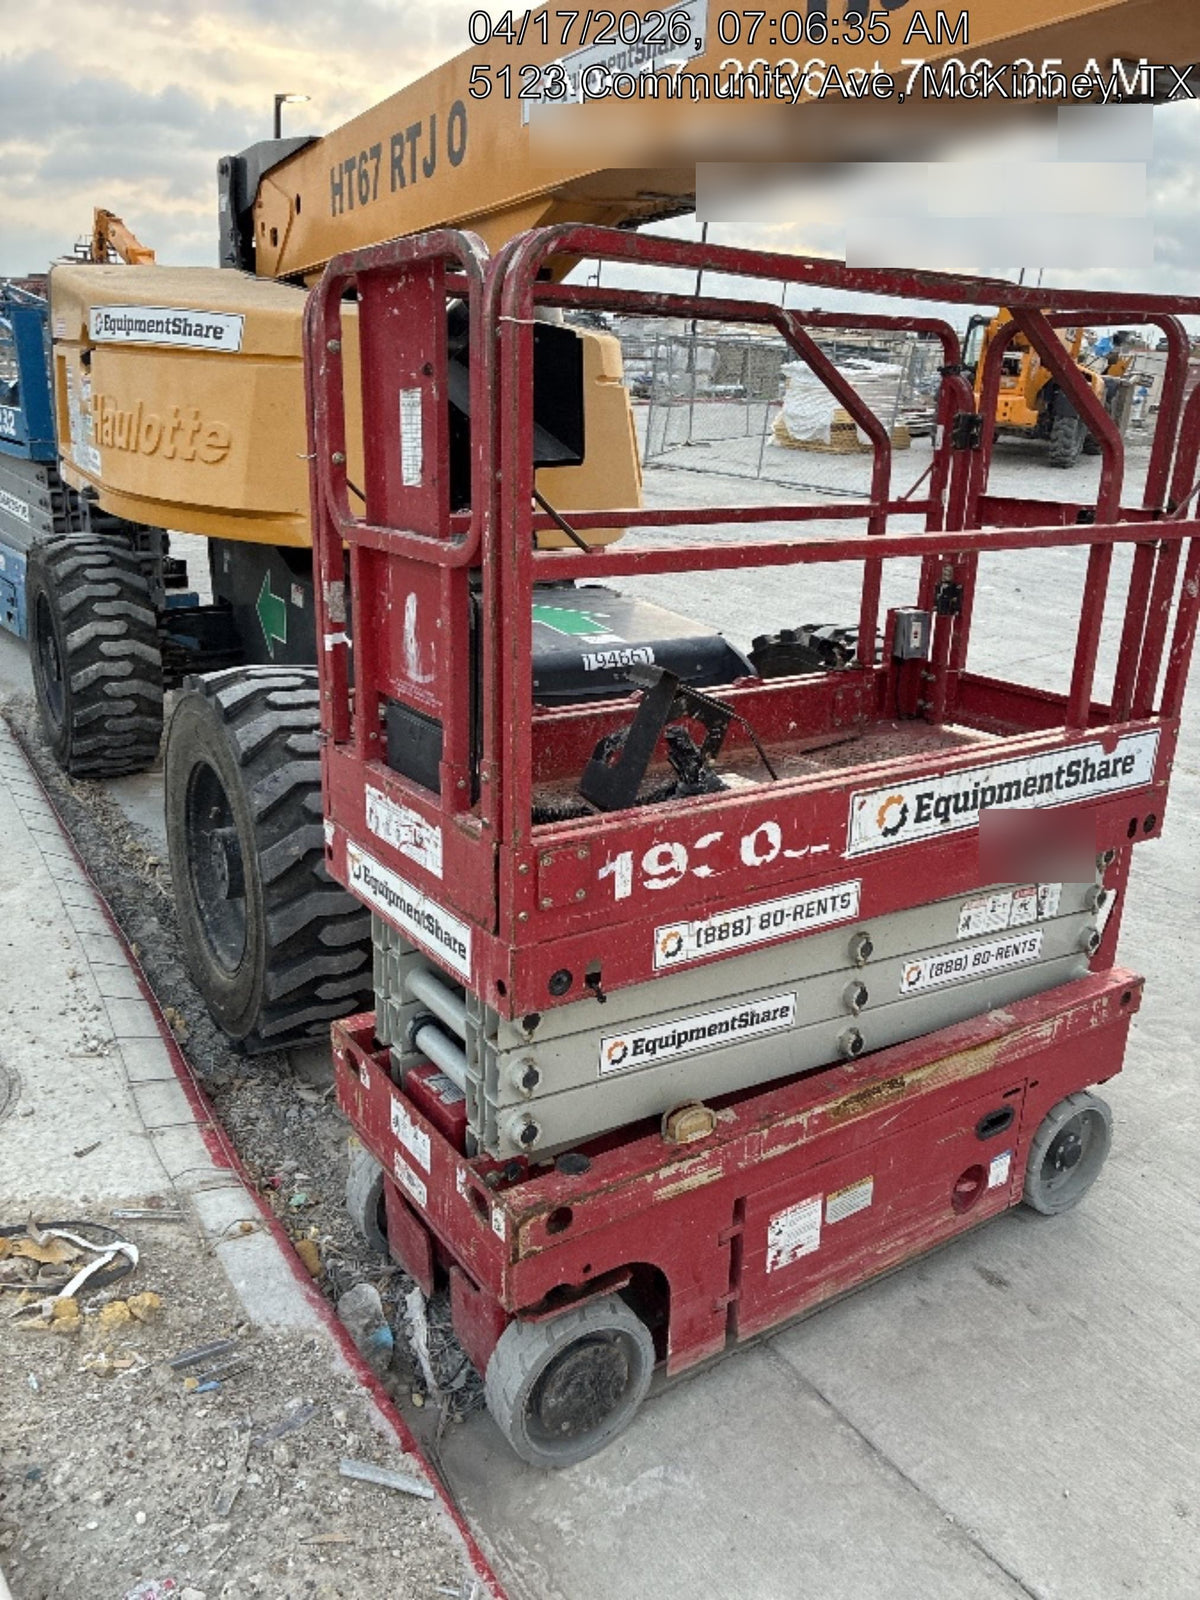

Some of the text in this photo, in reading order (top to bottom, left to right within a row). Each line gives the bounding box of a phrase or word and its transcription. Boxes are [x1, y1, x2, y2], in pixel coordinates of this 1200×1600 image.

[330, 142, 382, 217] HT67
[390, 113, 436, 193] RTJ
[104, 314, 225, 340] EquipmentShare
[94, 394, 231, 465] Haulotte
[913, 754, 1135, 824] EquipmentShare
[363, 865, 467, 960] EquipmentShare
[696, 892, 851, 948] (888) 80-RENTS
[929, 938, 1038, 980] (888) 80-RENTS
[630, 1005, 790, 1056] EquipmentShare
